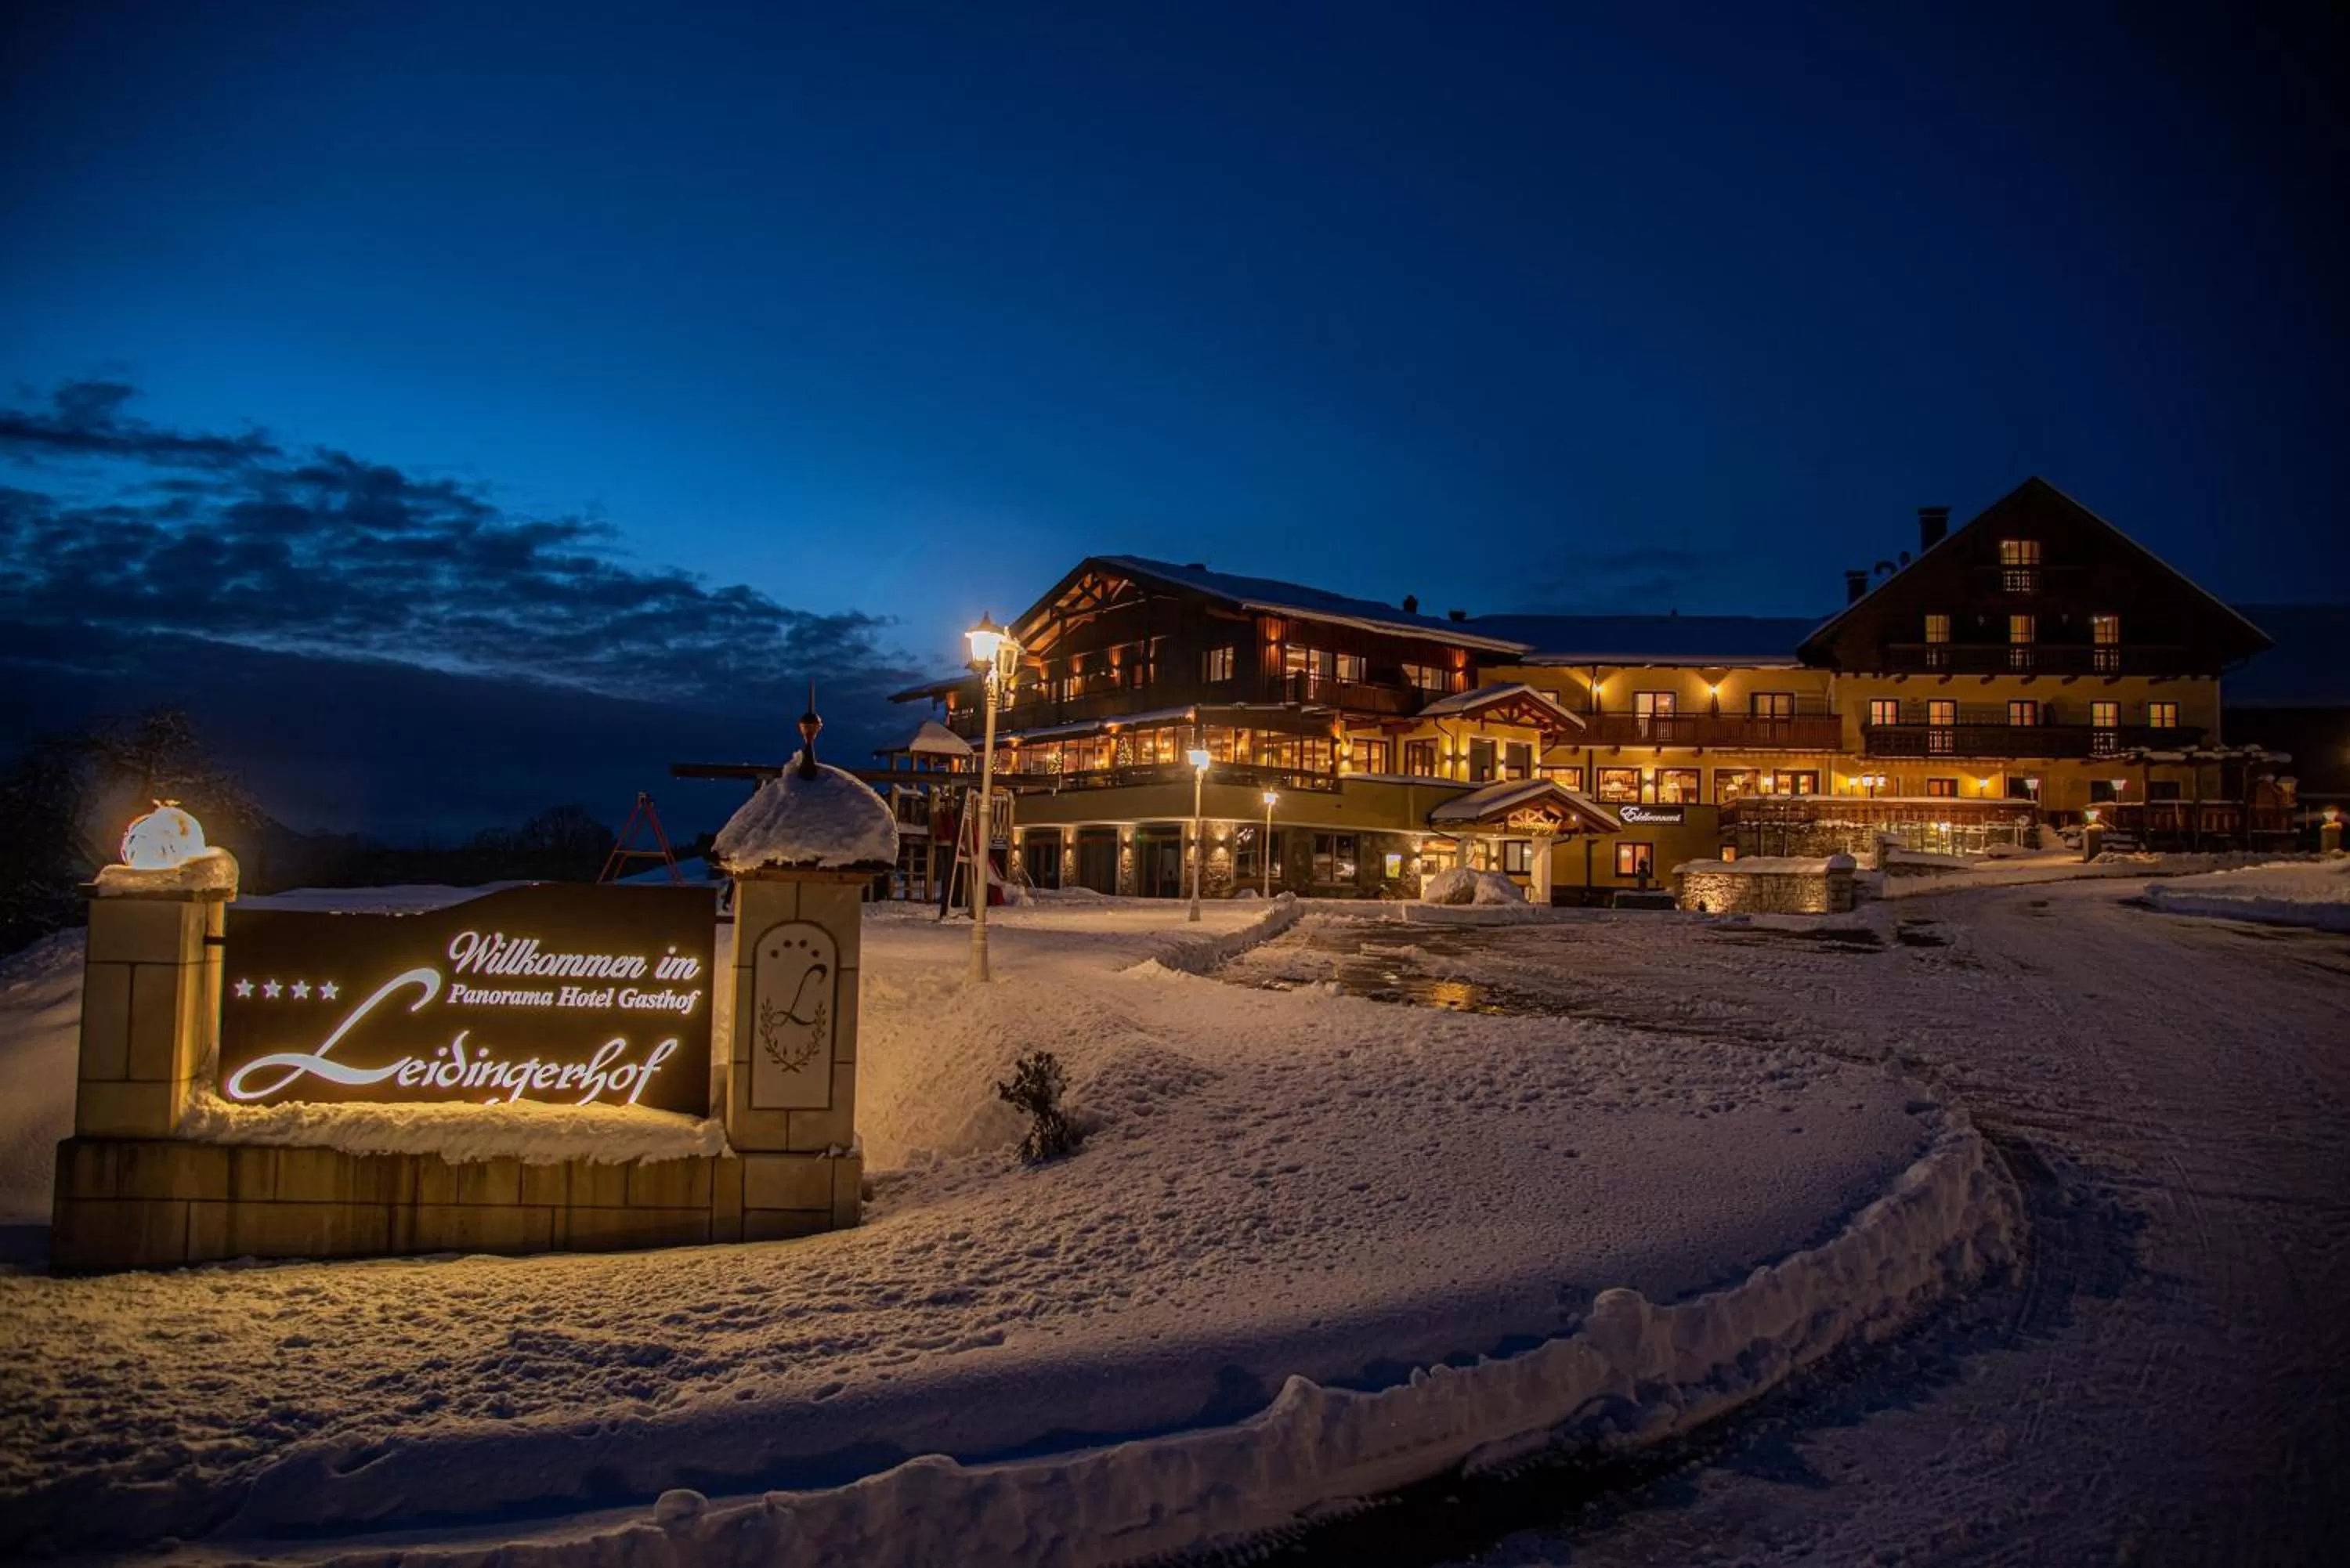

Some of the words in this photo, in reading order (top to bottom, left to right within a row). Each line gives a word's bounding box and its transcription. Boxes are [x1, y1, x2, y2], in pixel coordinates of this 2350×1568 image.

[448, 930, 648, 978] Willkommen
[654, 945, 701, 980] im
[446, 984, 553, 1006] Panorama
[556, 986, 615, 1008] Hotel
[618, 988, 702, 1014] Gasthof
[227, 966, 678, 1106] Leidingerhof
